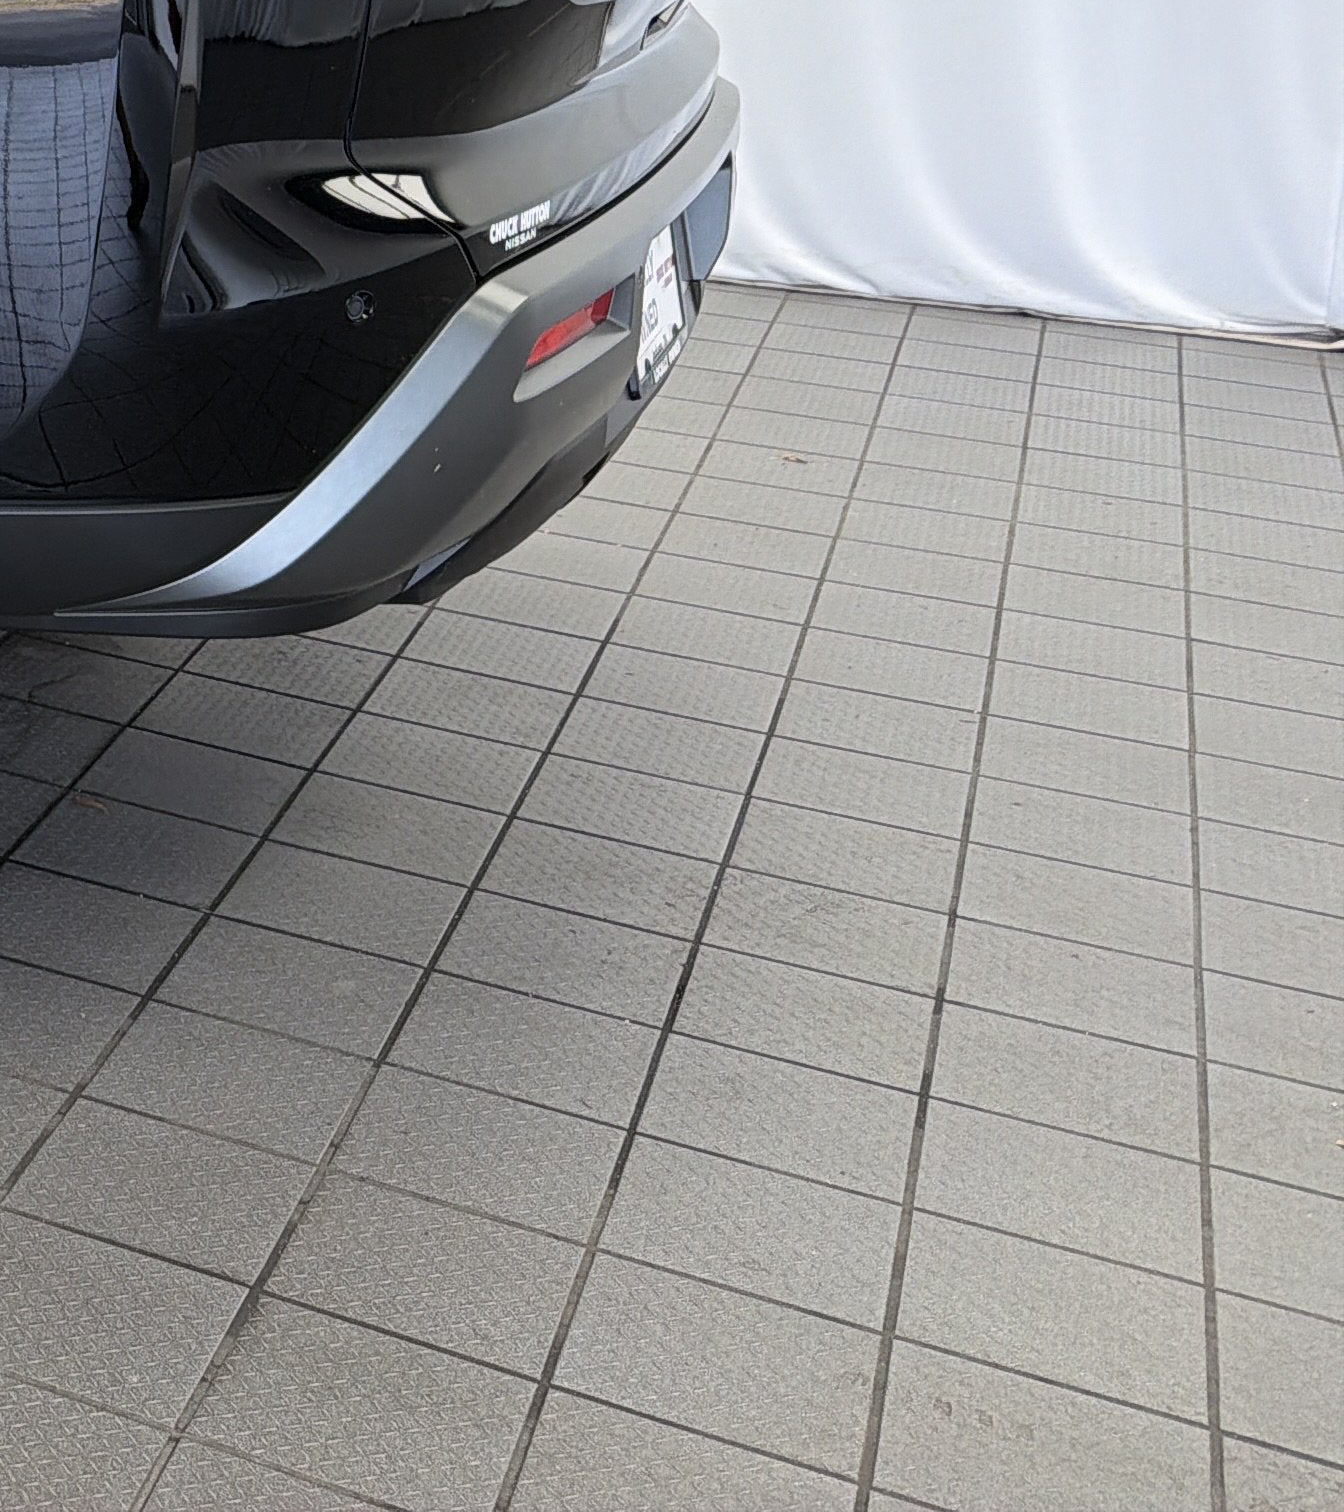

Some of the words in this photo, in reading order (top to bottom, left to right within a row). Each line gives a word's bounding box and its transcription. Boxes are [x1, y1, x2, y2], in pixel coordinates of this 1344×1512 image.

[489, 214, 519, 245] CHUCK
[520, 199, 551, 232] HUTTON
[504, 226, 537, 251] NISSAN
